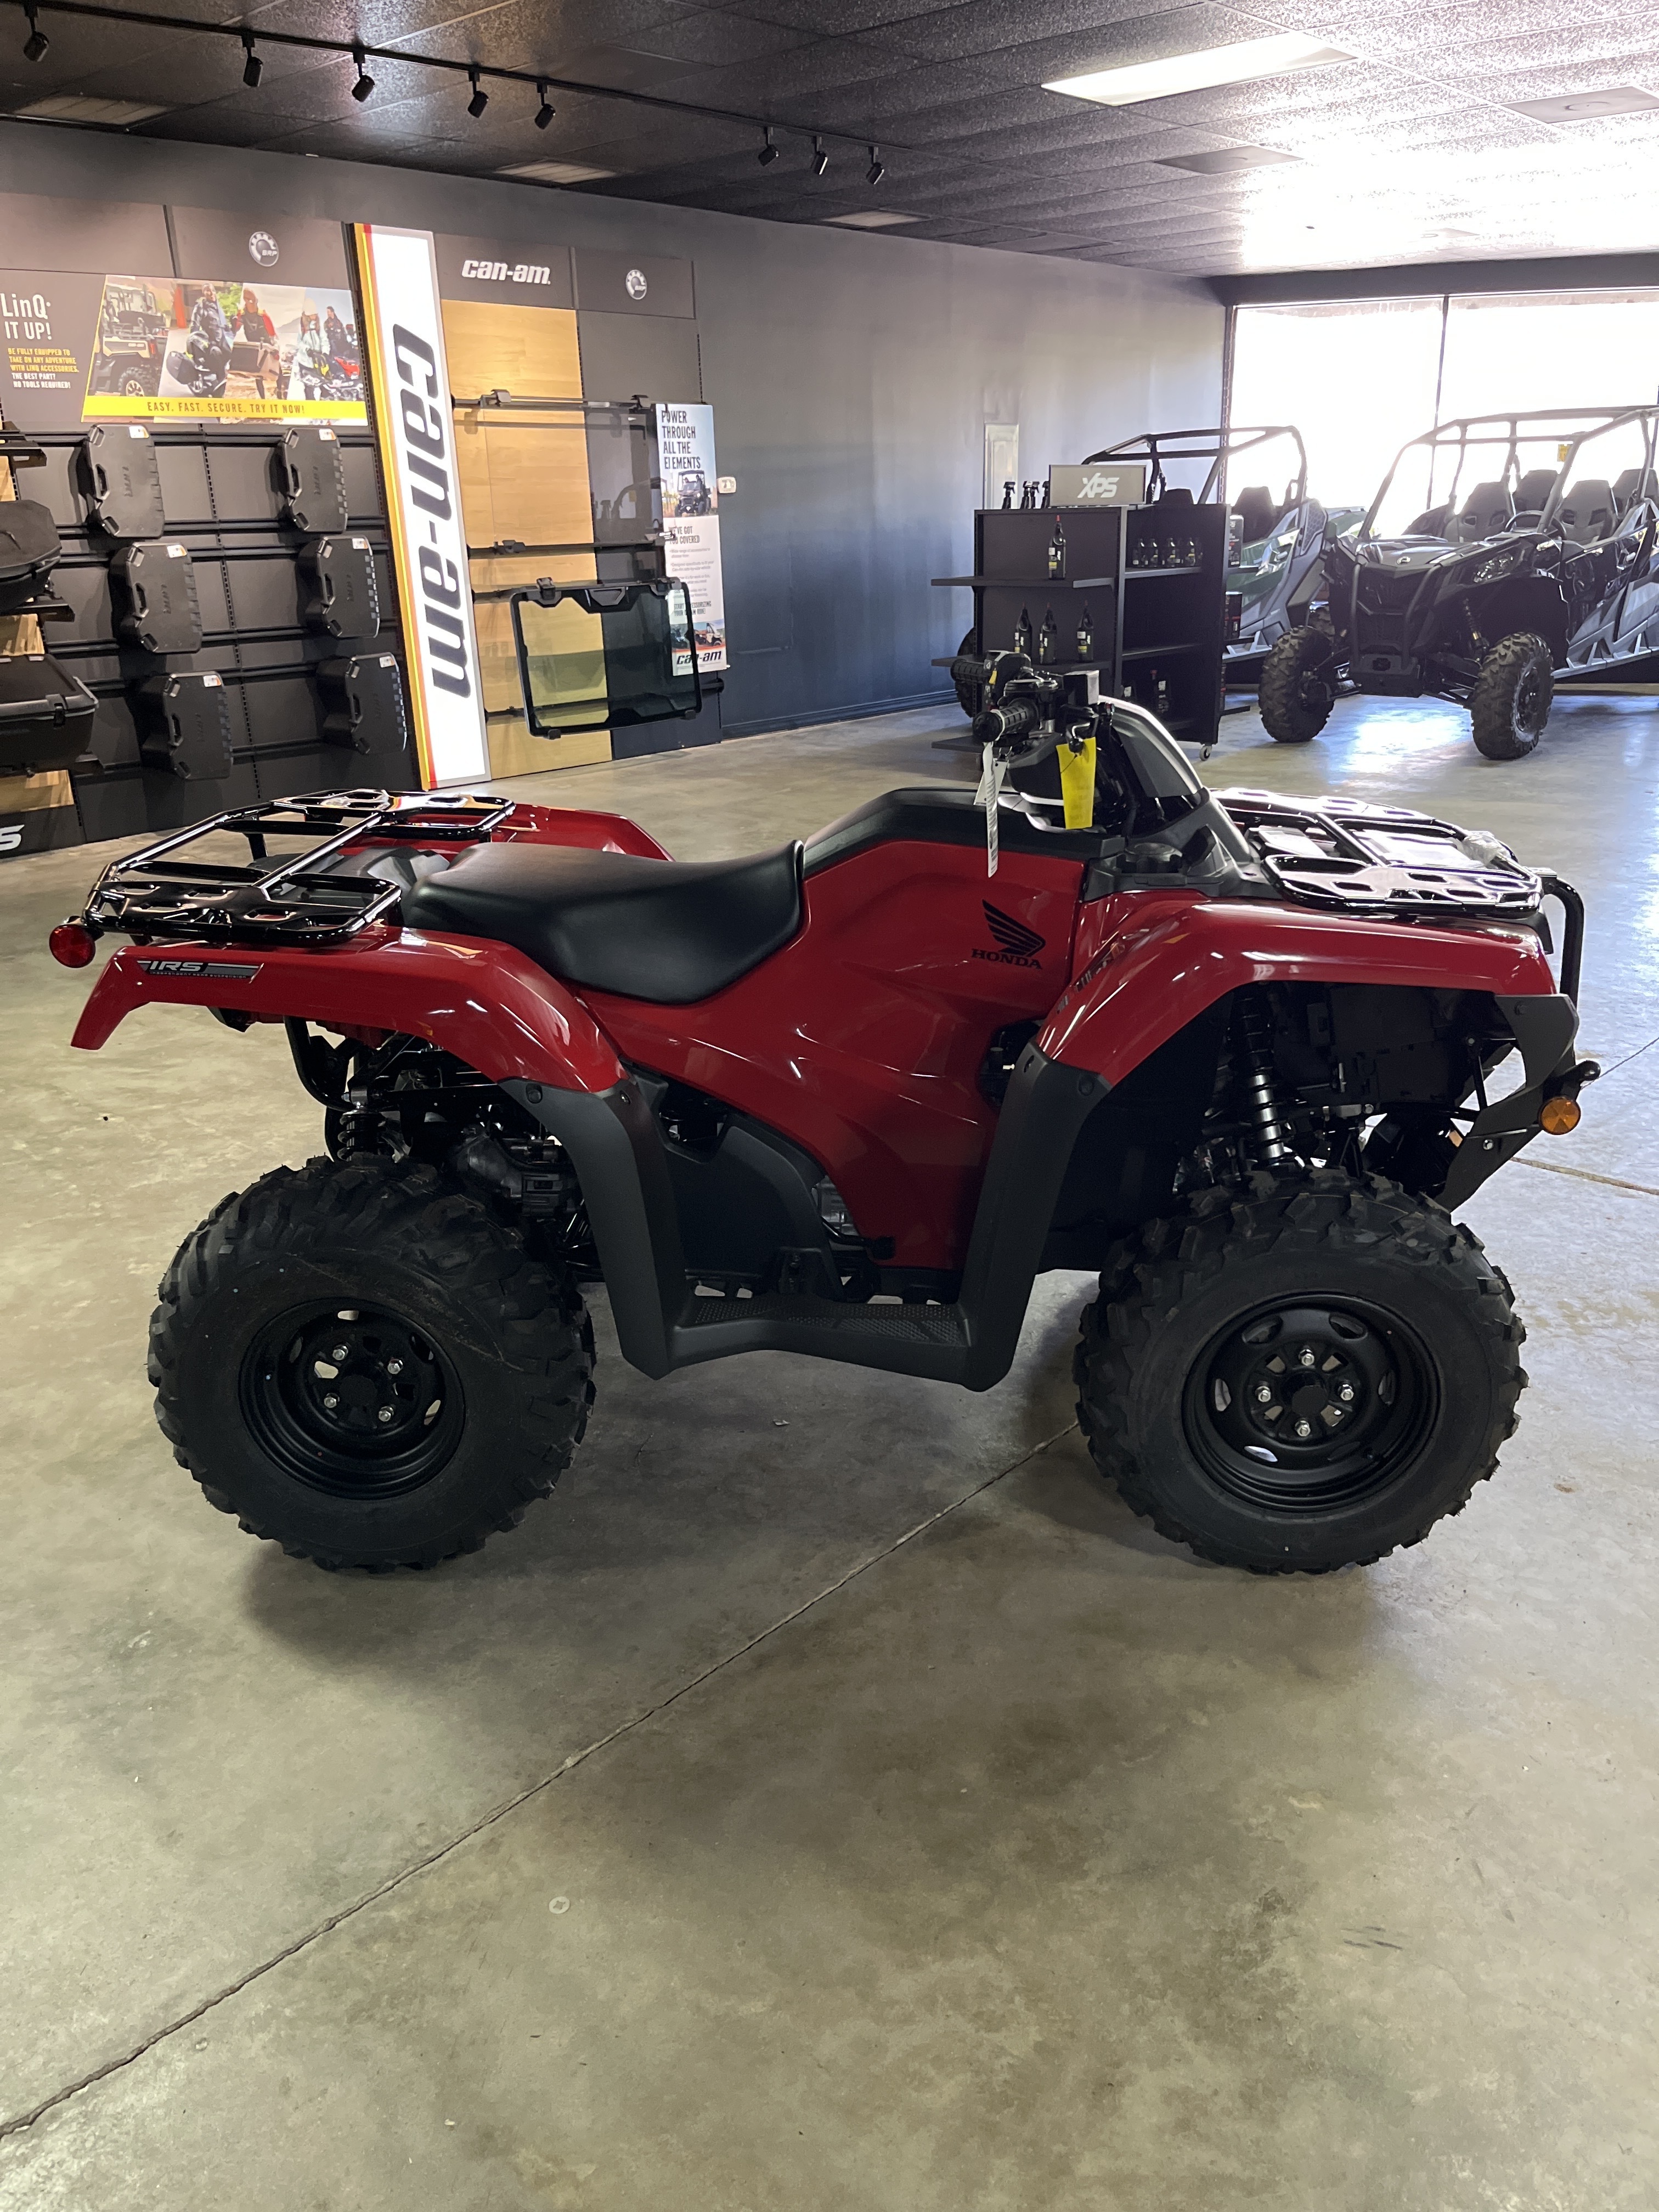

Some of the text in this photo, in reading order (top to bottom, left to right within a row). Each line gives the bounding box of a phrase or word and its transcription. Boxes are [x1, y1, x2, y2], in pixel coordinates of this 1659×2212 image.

[462, 260, 550, 285] can-am
[4, 321, 52, 340] IT UP!
[147, 402, 304, 414] EASY. FAST. SECURE. TRY IT NOW!
[661, 410, 687, 423] POWER
[662, 426, 696, 439] THROUGH
[663, 441, 691, 454] ALL THE
[664, 456, 701, 469] ELEMENTS
[1077, 472, 1119, 498] XPS
[393, 324, 471, 698] can-am
[684, 526, 692, 534] GOT
[680, 535, 699, 544] COVERED
[676, 651, 721, 665] ca-am
[971, 949, 1042, 970] HONDA
[150, 961, 204, 972] IRS
